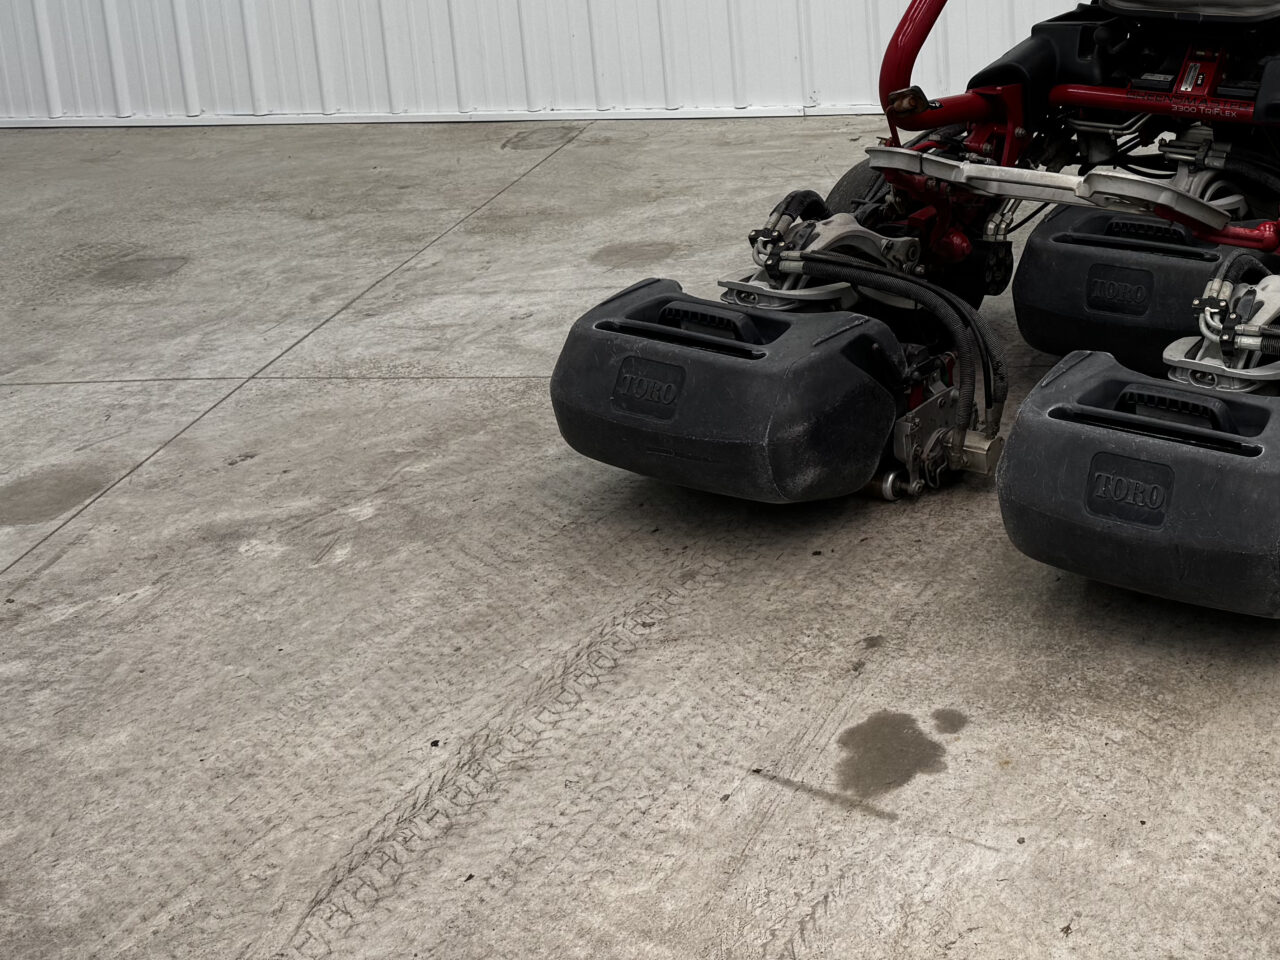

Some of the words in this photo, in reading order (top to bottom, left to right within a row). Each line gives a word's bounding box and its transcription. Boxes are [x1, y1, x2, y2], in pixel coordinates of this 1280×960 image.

[1172, 104, 1197, 114] 3300
[1091, 279, 1146, 305] TORO
[621, 374, 678, 406] TORO
[1094, 472, 1166, 511] TORO
